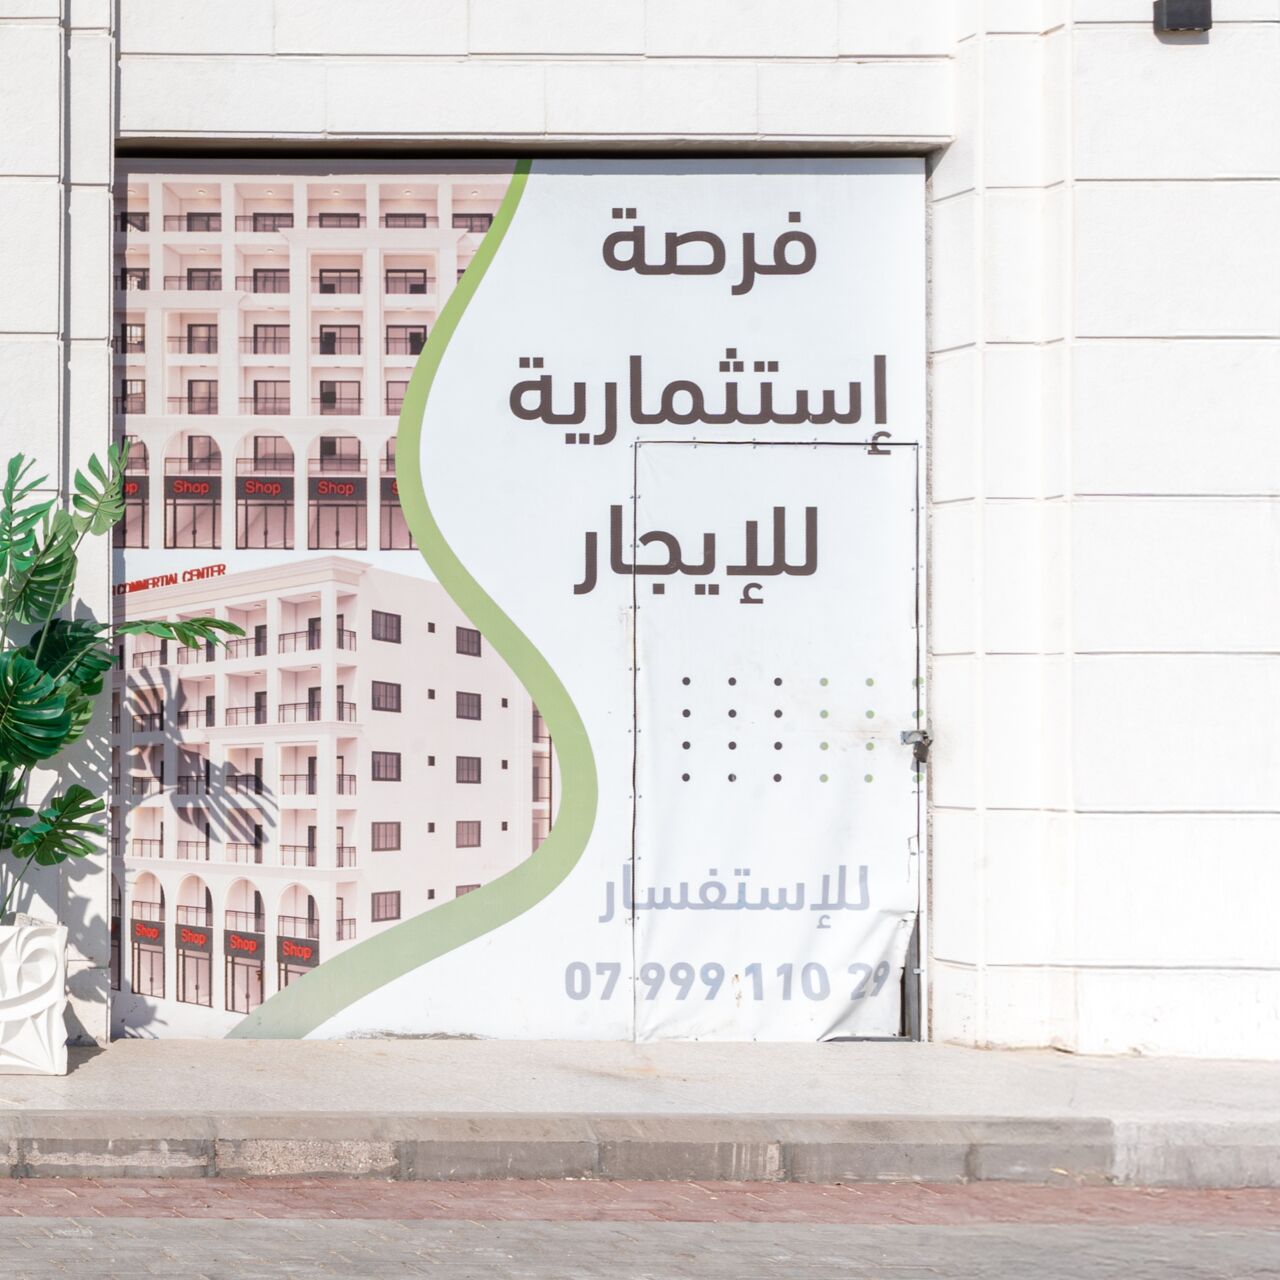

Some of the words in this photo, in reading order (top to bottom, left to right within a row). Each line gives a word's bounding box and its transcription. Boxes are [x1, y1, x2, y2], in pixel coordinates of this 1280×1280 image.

[602, 207, 817, 296] فرصة
[509, 347, 892, 456] إستثمارية
[173, 479, 210, 496] Shop
[245, 479, 282, 496] Shop
[318, 480, 355, 496] Shop
[573, 507, 818, 604] للإيجار
[182, 563, 226, 582] CENTER
[598, 864, 871, 929] للإستفسار
[134, 923, 160, 941] Shop
[181, 928, 207, 947] Shop
[229, 933, 258, 955] Shop
[282, 940, 313, 961] Shop
[564, 961, 622, 1001] 07
[640, 962, 726, 1001] 999
[744, 962, 831, 1001] 110
[847, 960, 891, 1001] 29
